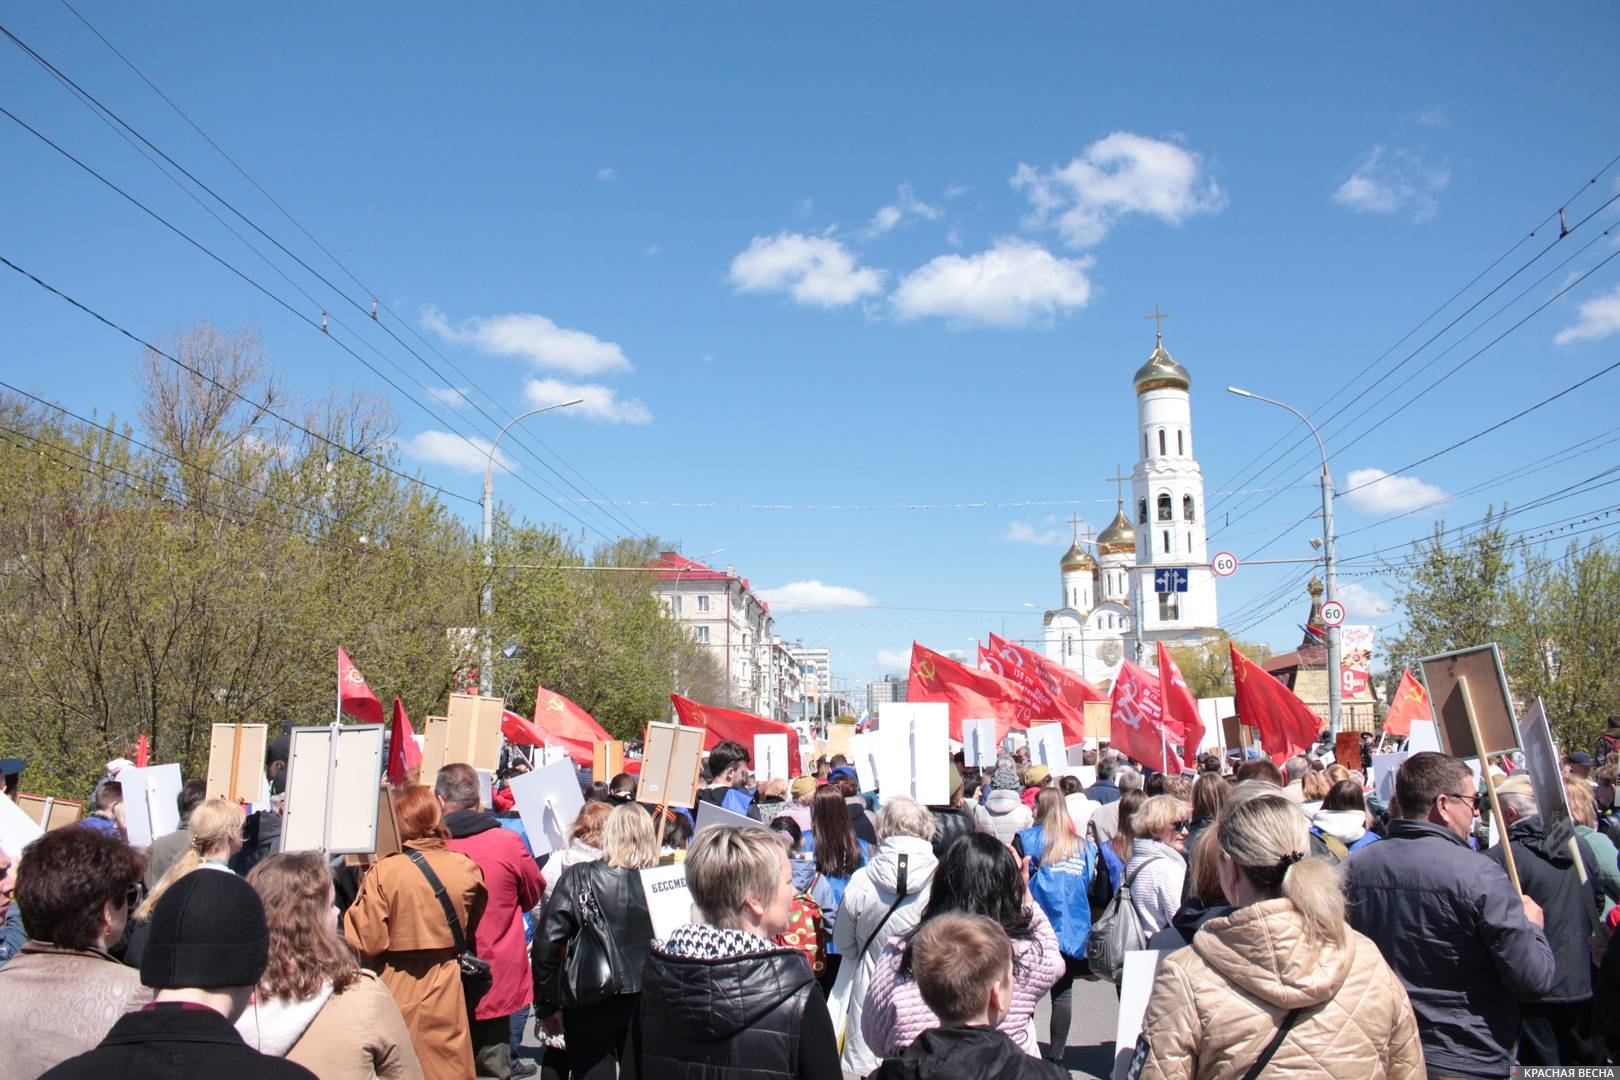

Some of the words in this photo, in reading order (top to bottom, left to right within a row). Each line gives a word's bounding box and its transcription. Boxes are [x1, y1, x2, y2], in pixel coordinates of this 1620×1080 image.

[1217, 559, 1233, 570] 60
[1325, 608, 1341, 619] 60
[1343, 670, 1354, 691] 9
[651, 878, 687, 893] БЕССМЕ
